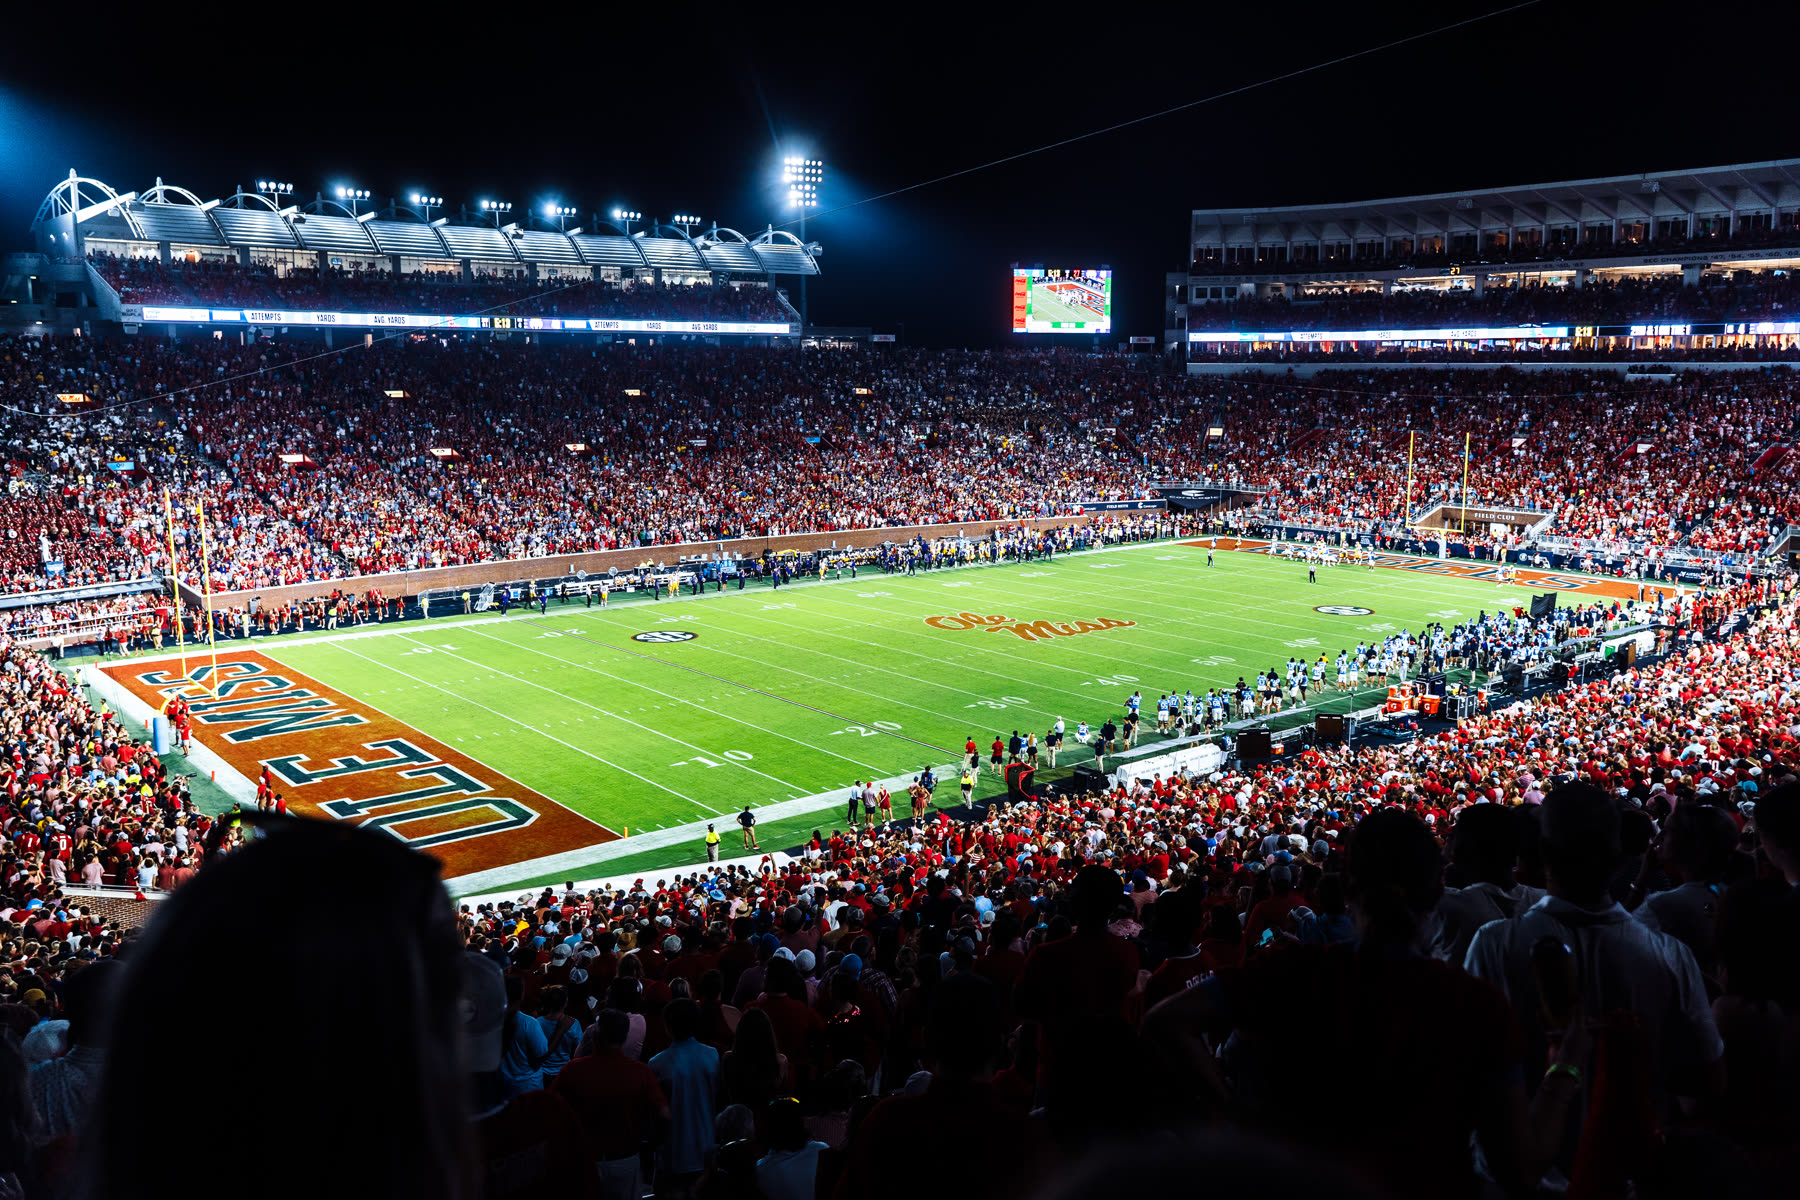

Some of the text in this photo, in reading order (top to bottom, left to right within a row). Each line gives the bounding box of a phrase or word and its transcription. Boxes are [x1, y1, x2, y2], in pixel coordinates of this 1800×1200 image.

[1450, 266, 1460, 275] 27
[251, 312, 282, 321] ATTEMPTS
[317, 314, 336, 322] YARDS
[374, 315, 405, 324] AVG. YARDS
[594, 321, 619, 329] ATTEMPTS
[646, 322, 662, 330] YARDS
[703, 323, 718, 331] YARDS
[1300, 332, 1323, 340] ATTEMPTS
[923, 612, 1138, 642] Ole Miss
[542, 628, 588, 639] 20
[635, 631, 694, 643] SEC
[412, 643, 463, 654] 10
[1191, 655, 1236, 666] 50
[1096, 673, 1140, 687] 40
[978, 695, 1030, 710] 30
[845, 720, 903, 738] 20
[135, 661, 541, 850] OLE MISS
[689, 749, 755, 769] 10
[28, 838, 33, 847] 1
[60, 839, 67, 851] 0
